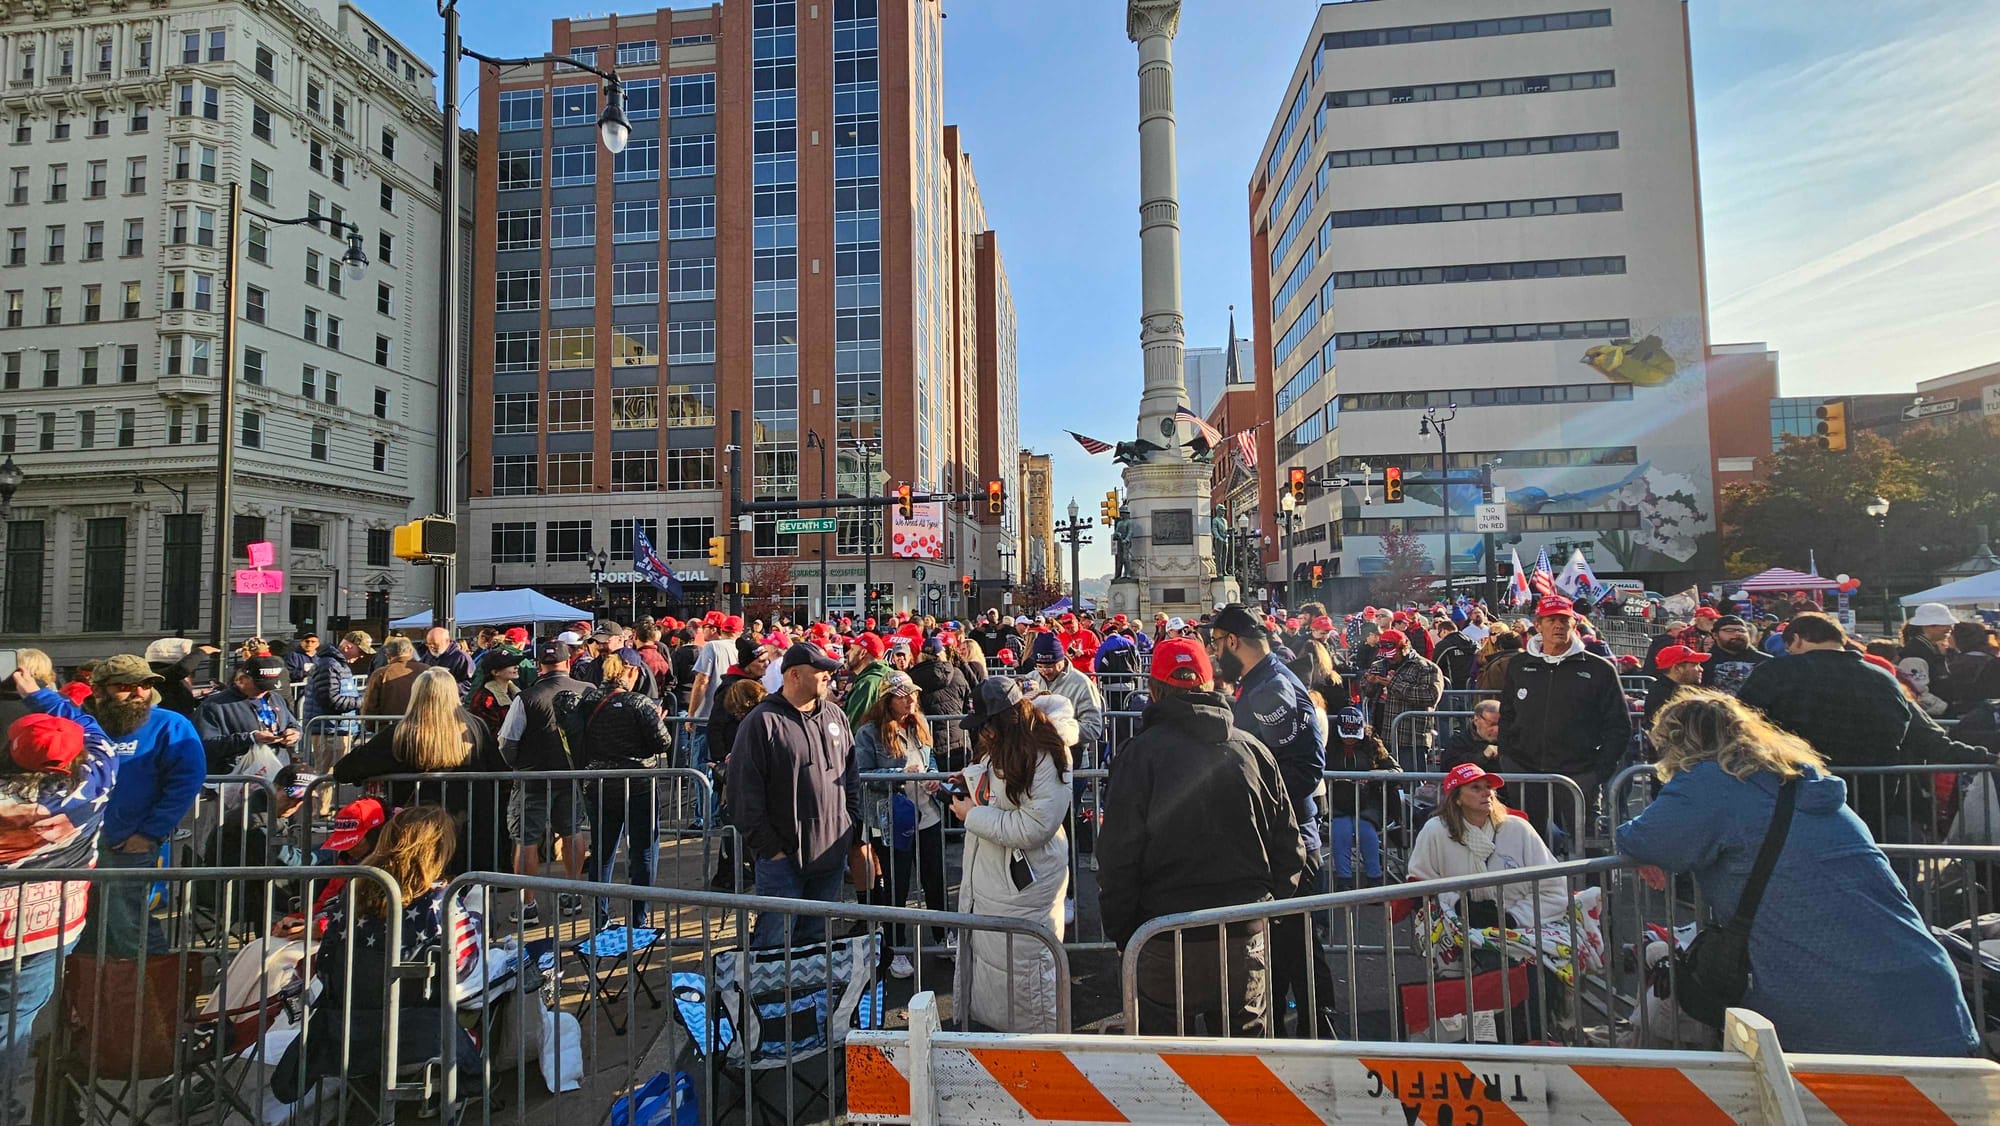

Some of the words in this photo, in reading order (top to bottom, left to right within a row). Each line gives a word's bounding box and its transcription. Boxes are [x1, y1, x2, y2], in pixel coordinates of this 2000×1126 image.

[1482, 514, 1501, 522] TURN
[779, 521, 820, 531] SEVENTH
[822, 520, 834, 529] ST
[1490, 522, 1505, 530] RED
[1367, 1069, 1528, 1102] TRAFFIC
